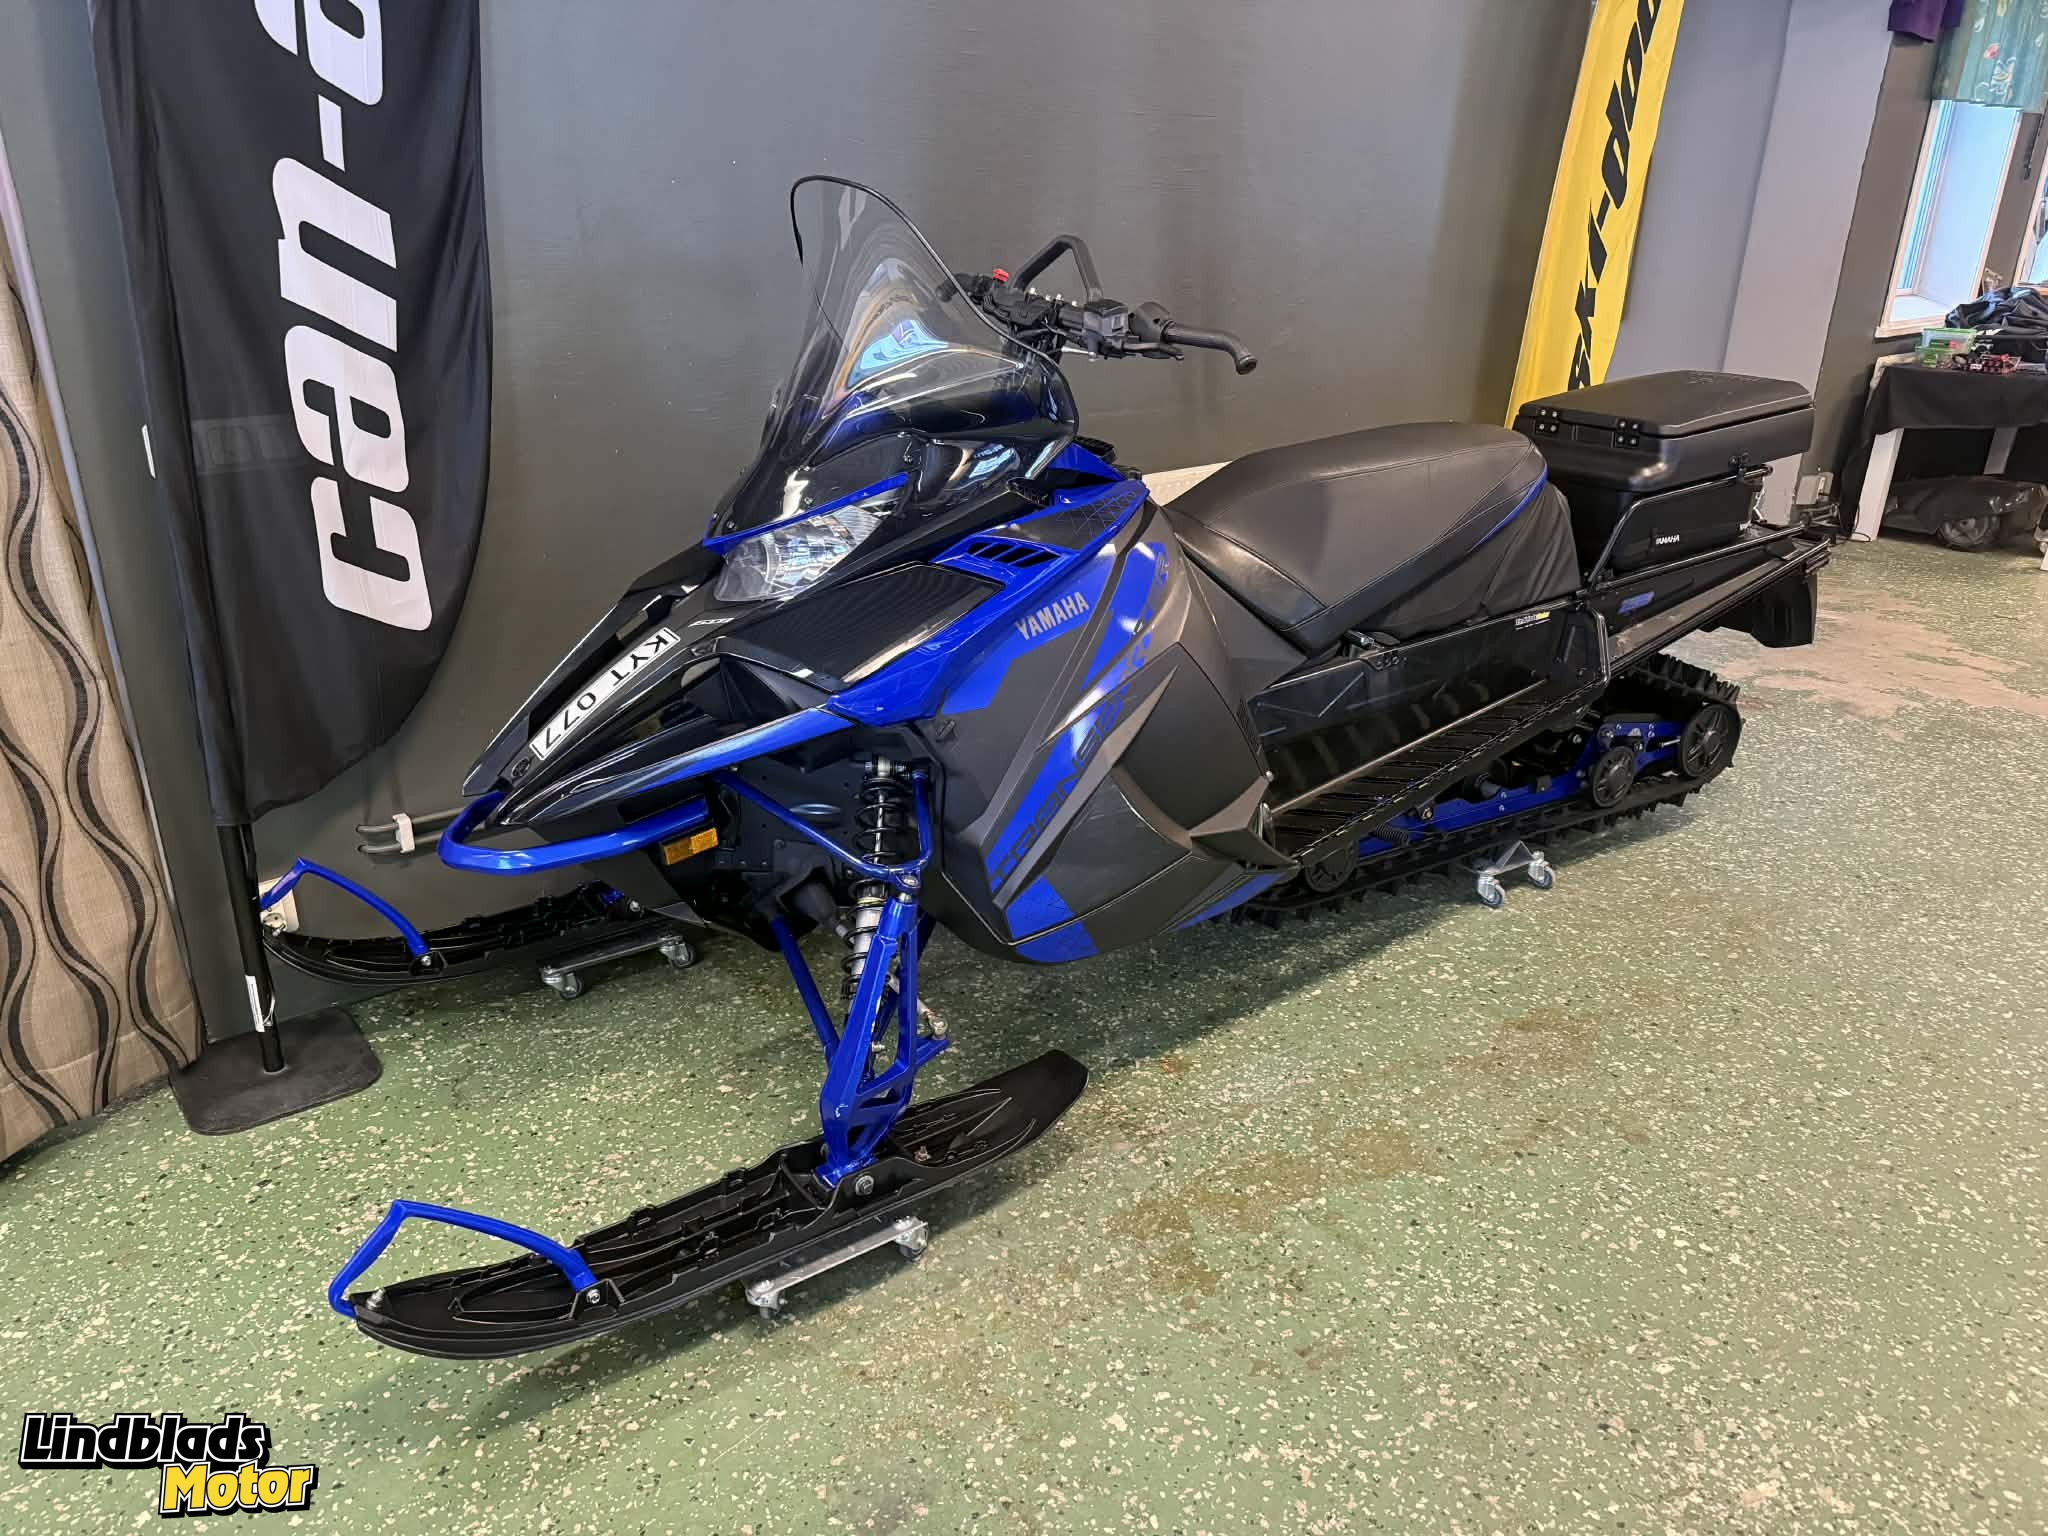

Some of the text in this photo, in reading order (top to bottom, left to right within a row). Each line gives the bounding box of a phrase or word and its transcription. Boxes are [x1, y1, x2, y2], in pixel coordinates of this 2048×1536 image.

[1014, 591, 1090, 641] YAMAHA
[545, 634, 669, 750] KYT 077
